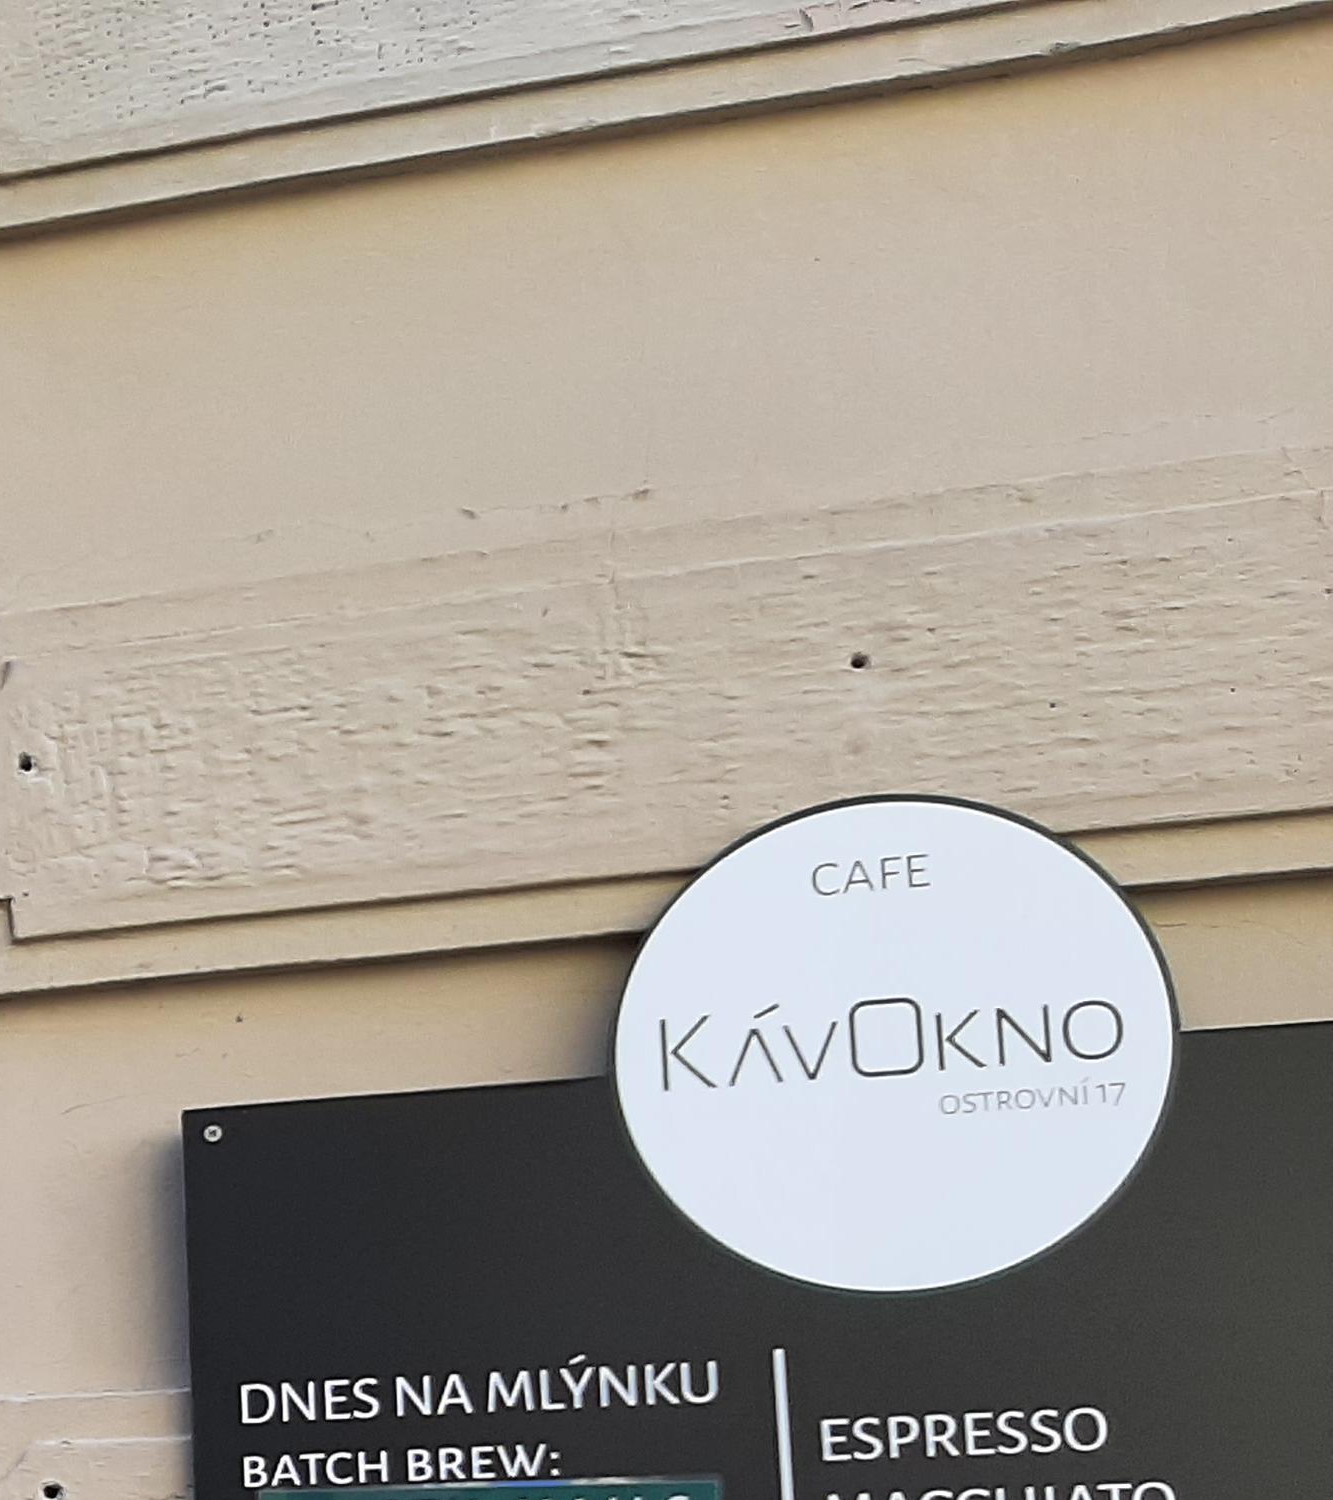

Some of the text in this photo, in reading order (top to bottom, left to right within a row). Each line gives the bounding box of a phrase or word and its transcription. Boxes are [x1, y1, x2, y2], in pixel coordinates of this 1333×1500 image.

[810, 853, 932, 897] CAFE
[658, 997, 1125, 1092] KÁVOKNO
[937, 1076, 1127, 1115] OSTROVNÍ 17
[240, 1354, 719, 1424] DNES NA MLÝNKU
[820, 1407, 1108, 1462] ESPRESSO
[243, 1443, 561, 1488] BATCH BREW:
